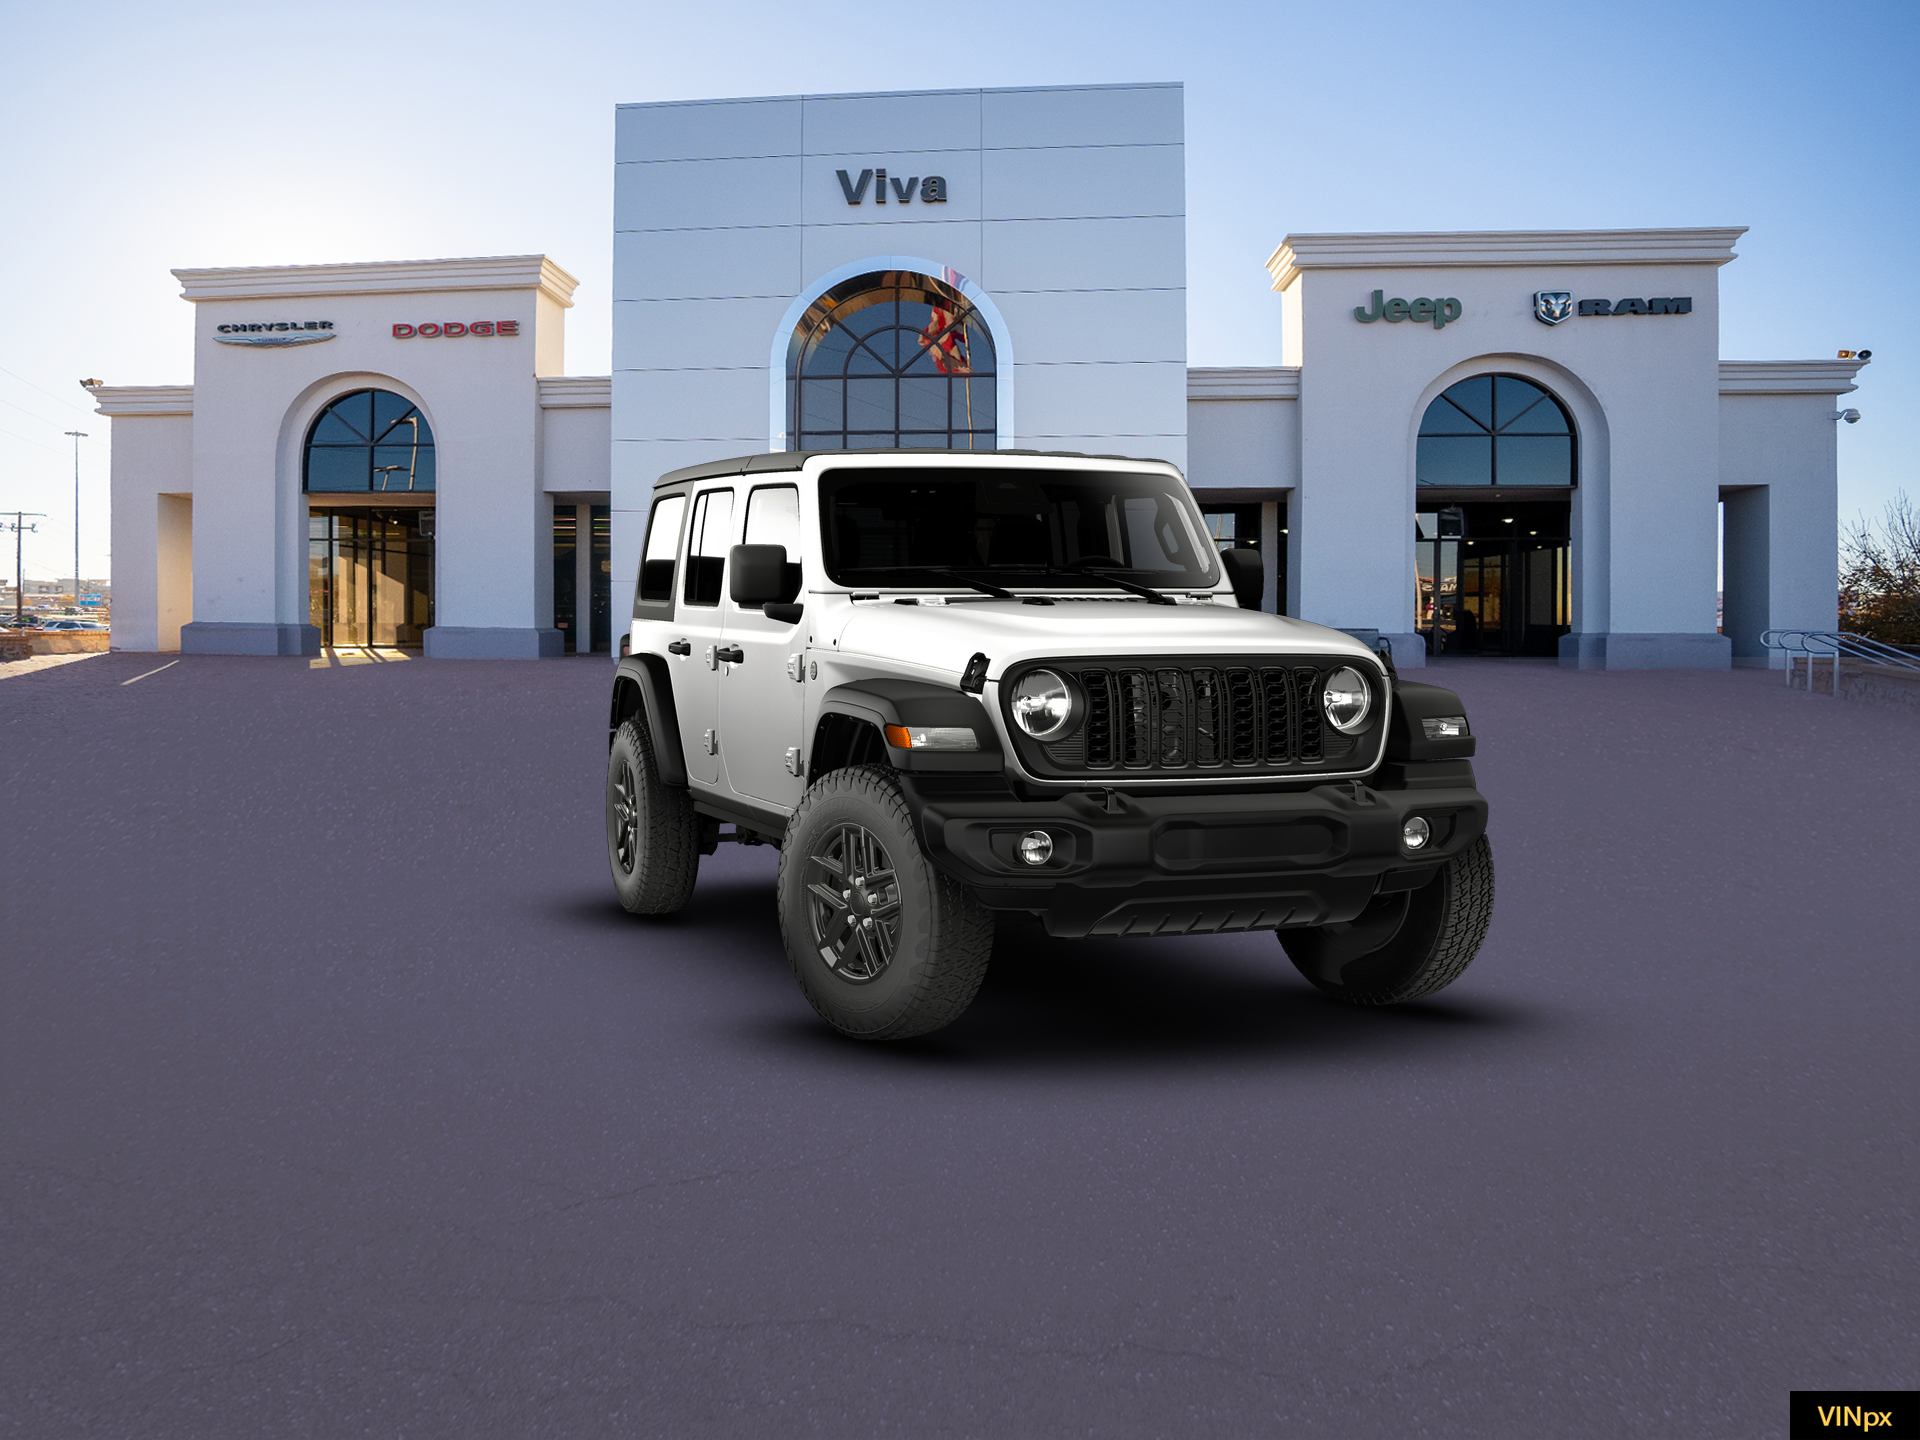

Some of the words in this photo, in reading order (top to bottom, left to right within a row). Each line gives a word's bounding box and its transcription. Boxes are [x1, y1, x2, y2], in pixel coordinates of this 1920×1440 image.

[835, 168, 948, 205] Viva
[1353, 289, 1463, 329] Jeep
[1578, 296, 1692, 316] RAM
[216, 320, 334, 334] CHRYSLER
[392, 319, 520, 339] DODGE
